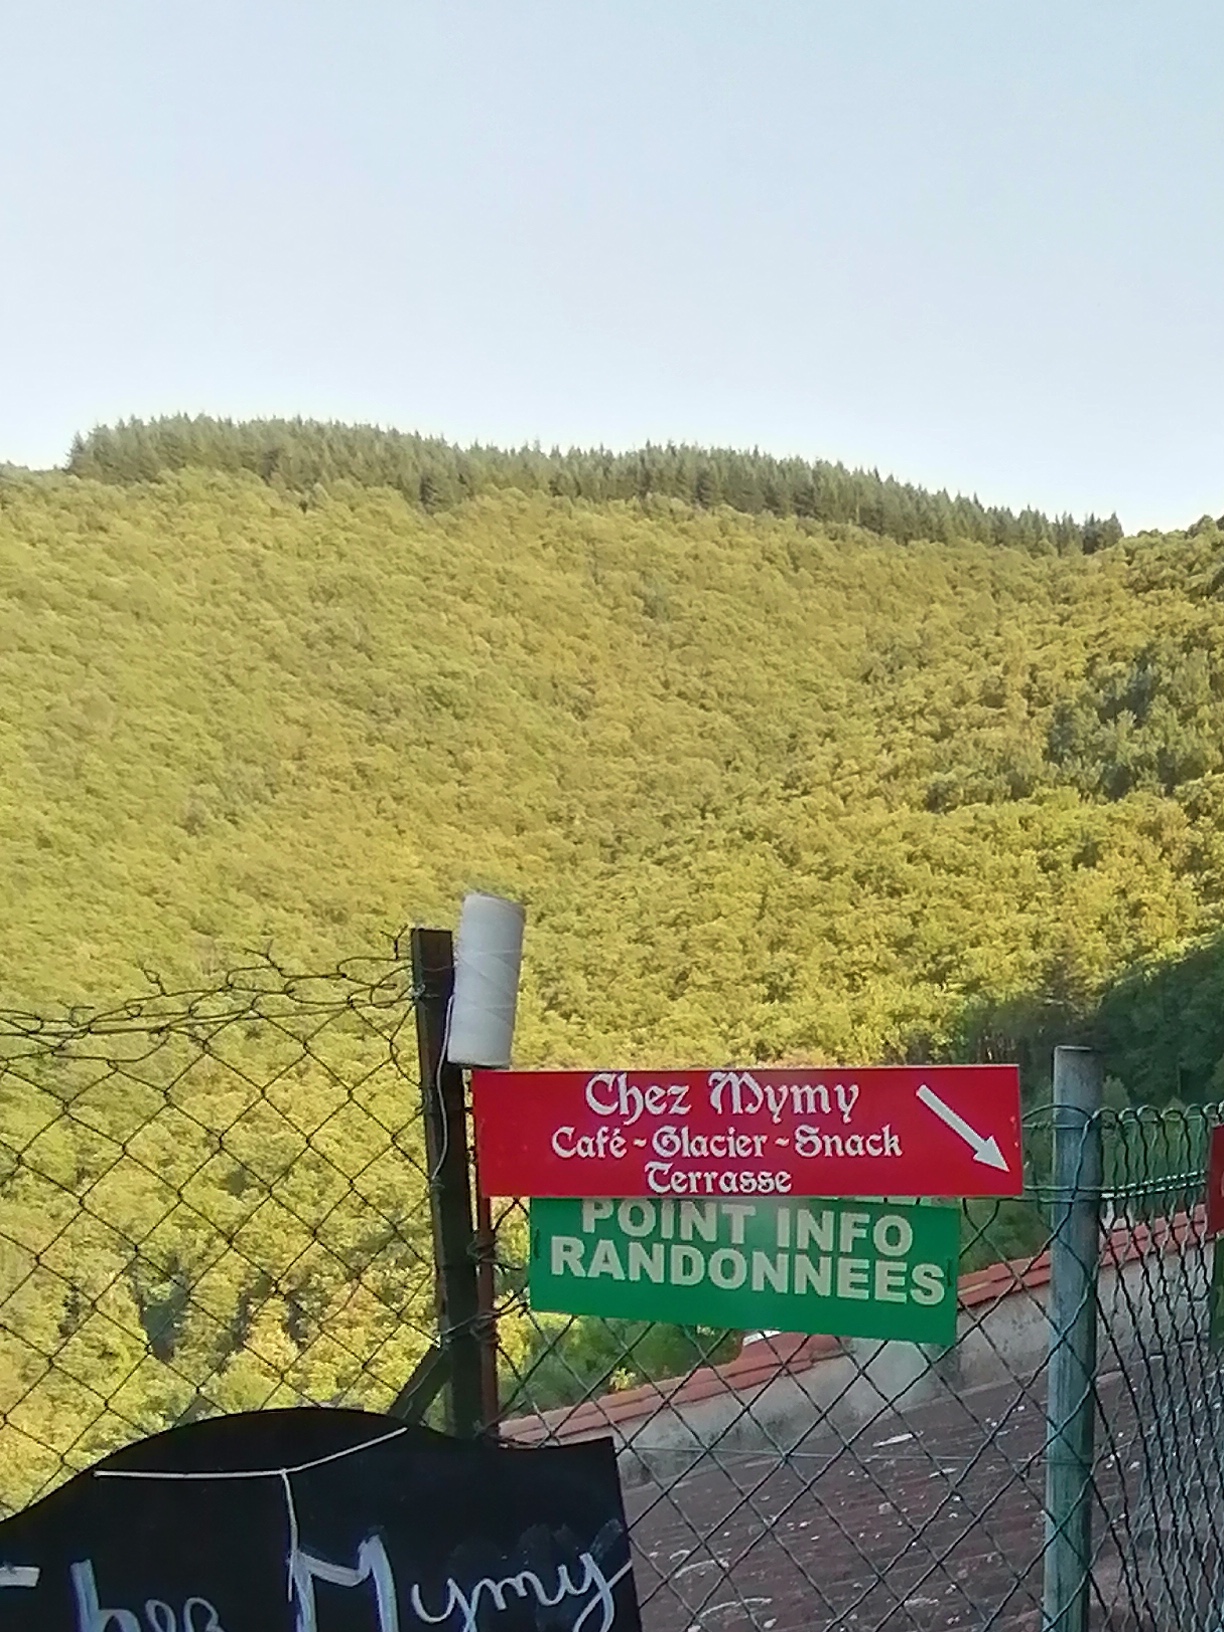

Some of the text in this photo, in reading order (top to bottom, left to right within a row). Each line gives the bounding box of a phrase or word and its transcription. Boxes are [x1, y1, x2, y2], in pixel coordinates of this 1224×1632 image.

[585, 1070, 860, 1126] Chez Mymy
[551, 1126, 627, 1159] Café
[651, 1125, 768, 1159] Glacier
[794, 1124, 903, 1158] Snack
[644, 1162, 793, 1195] Terrasse
[581, 1198, 914, 1258] POINT INFO
[550, 1235, 947, 1307] RANDONNEES
